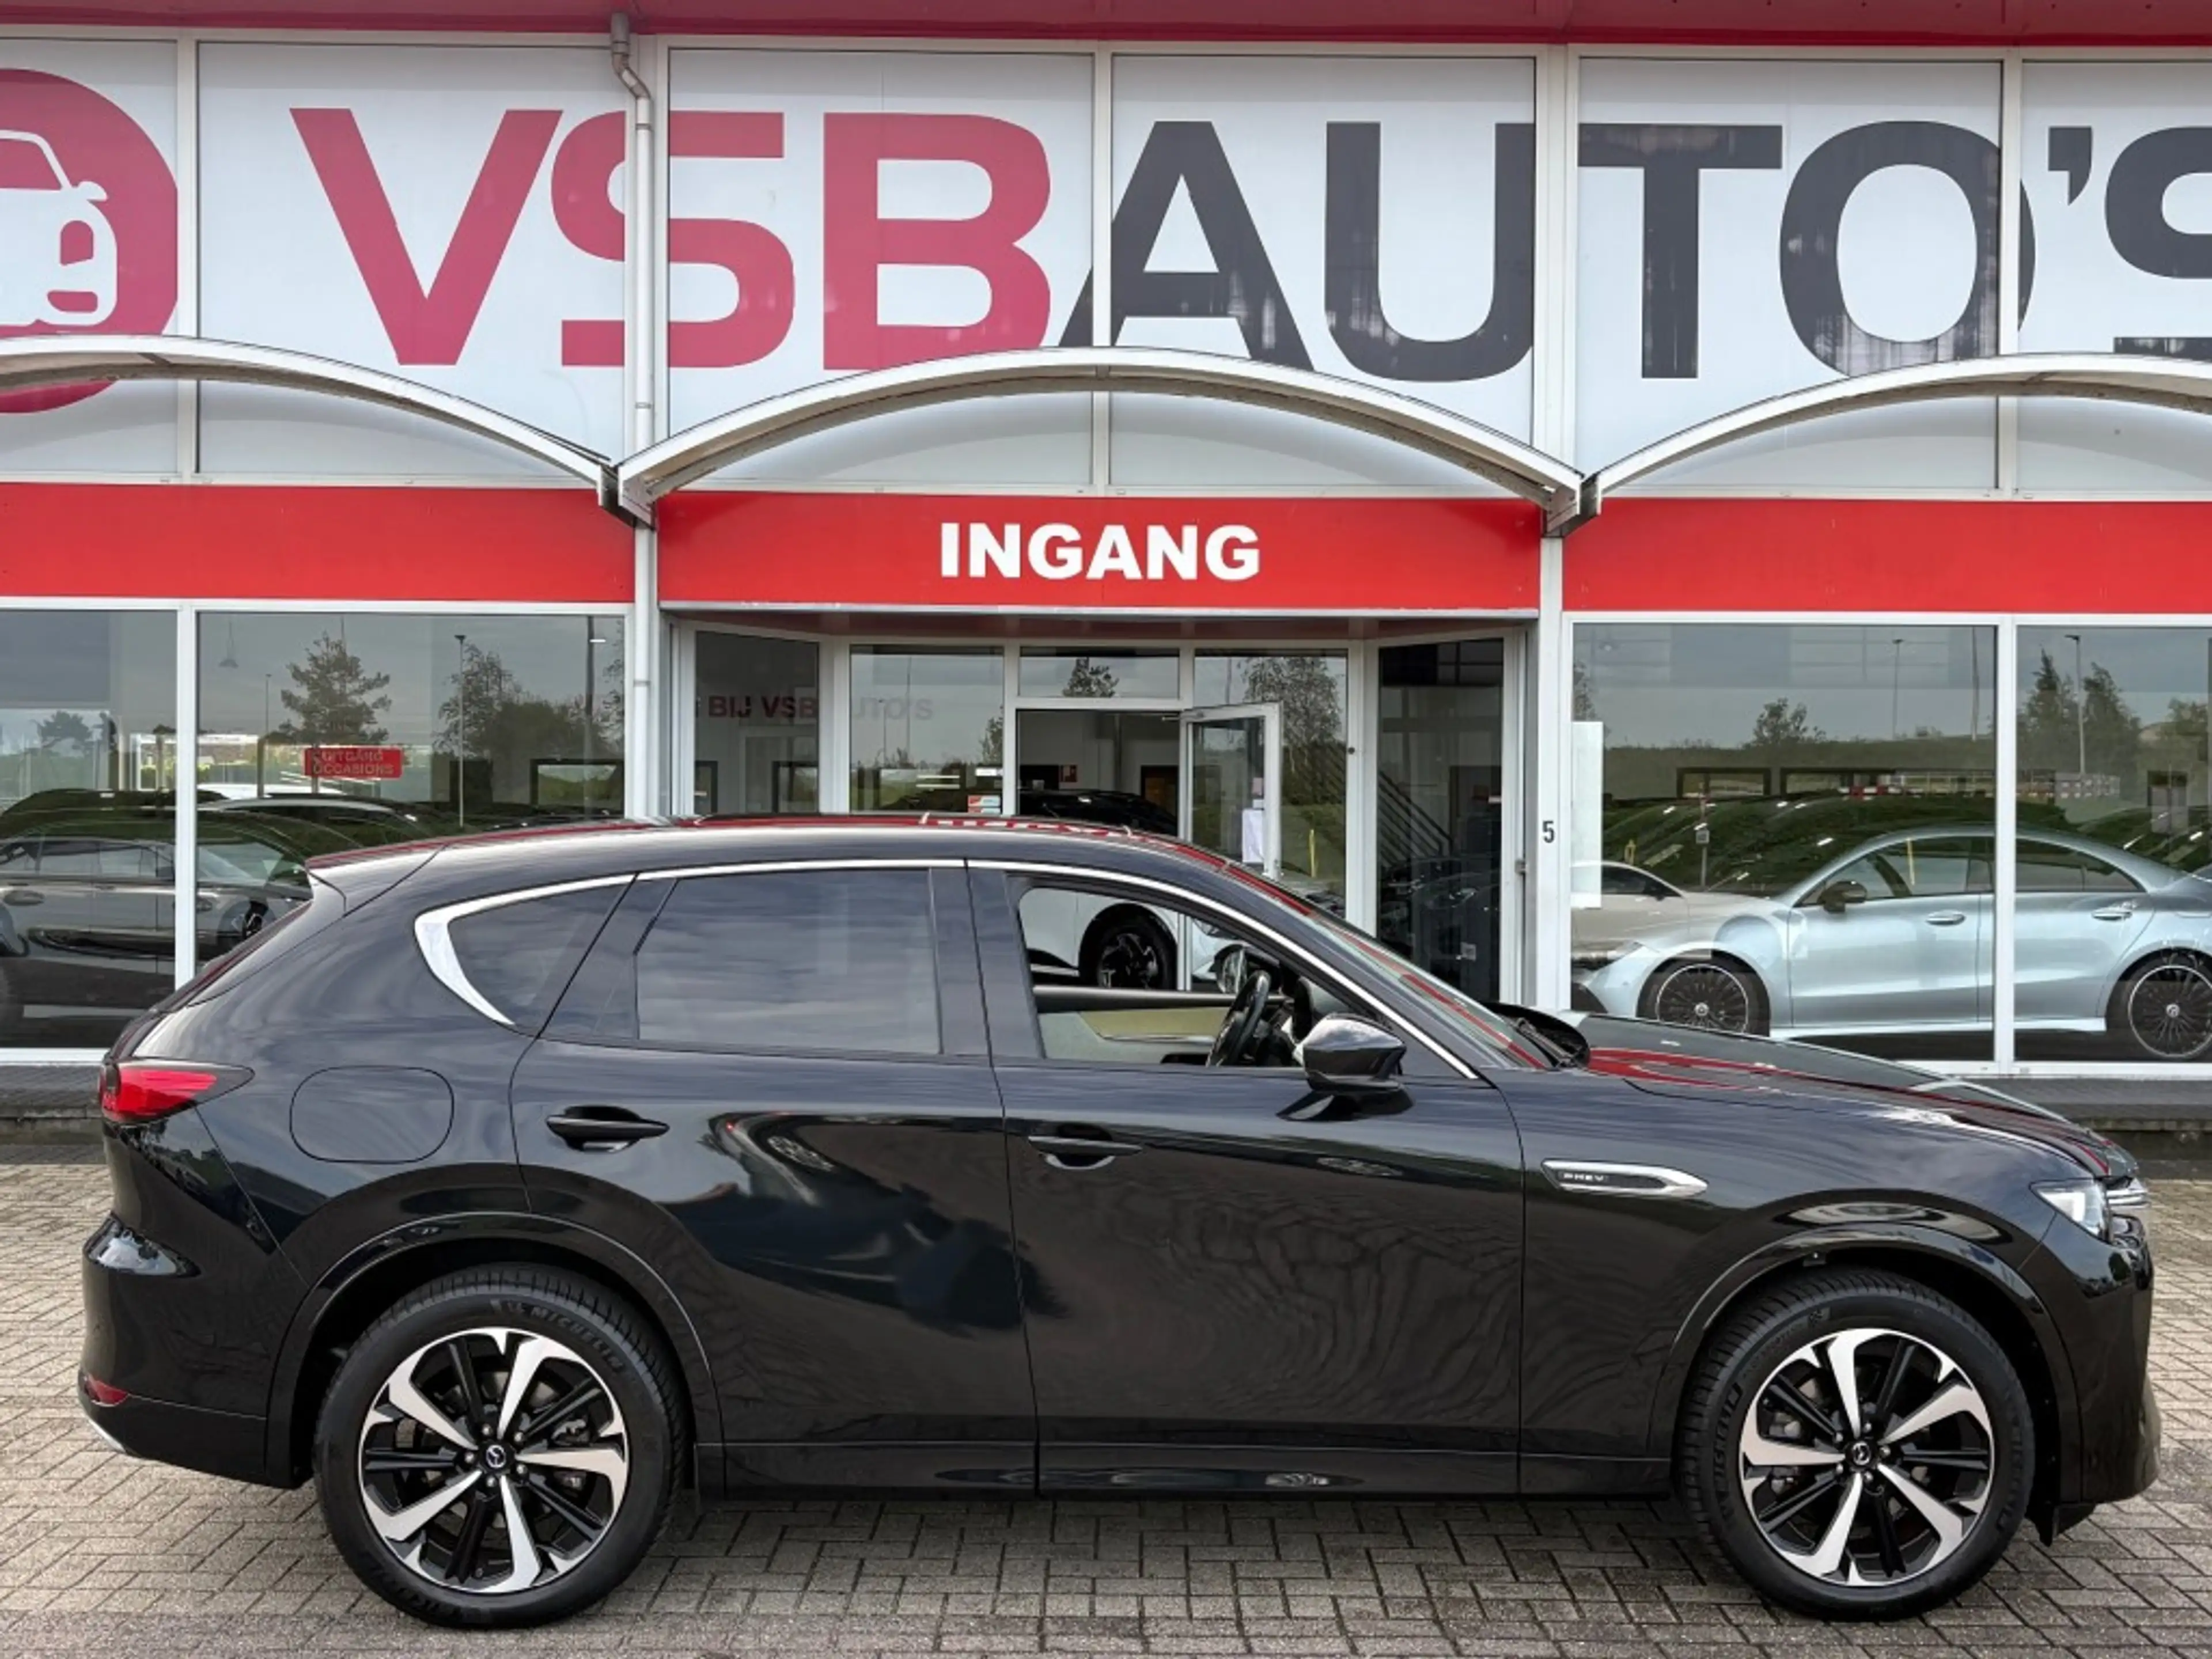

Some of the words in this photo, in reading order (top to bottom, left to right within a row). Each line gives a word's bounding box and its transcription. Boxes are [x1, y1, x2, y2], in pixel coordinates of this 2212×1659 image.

[941, 522, 1260, 580] INGANG
[709, 695, 751, 718] BIJ
[1542, 820, 1555, 843] 5
[1563, 1172, 1604, 1181] PHEV
[531, 1305, 624, 1370] MICHELIN
